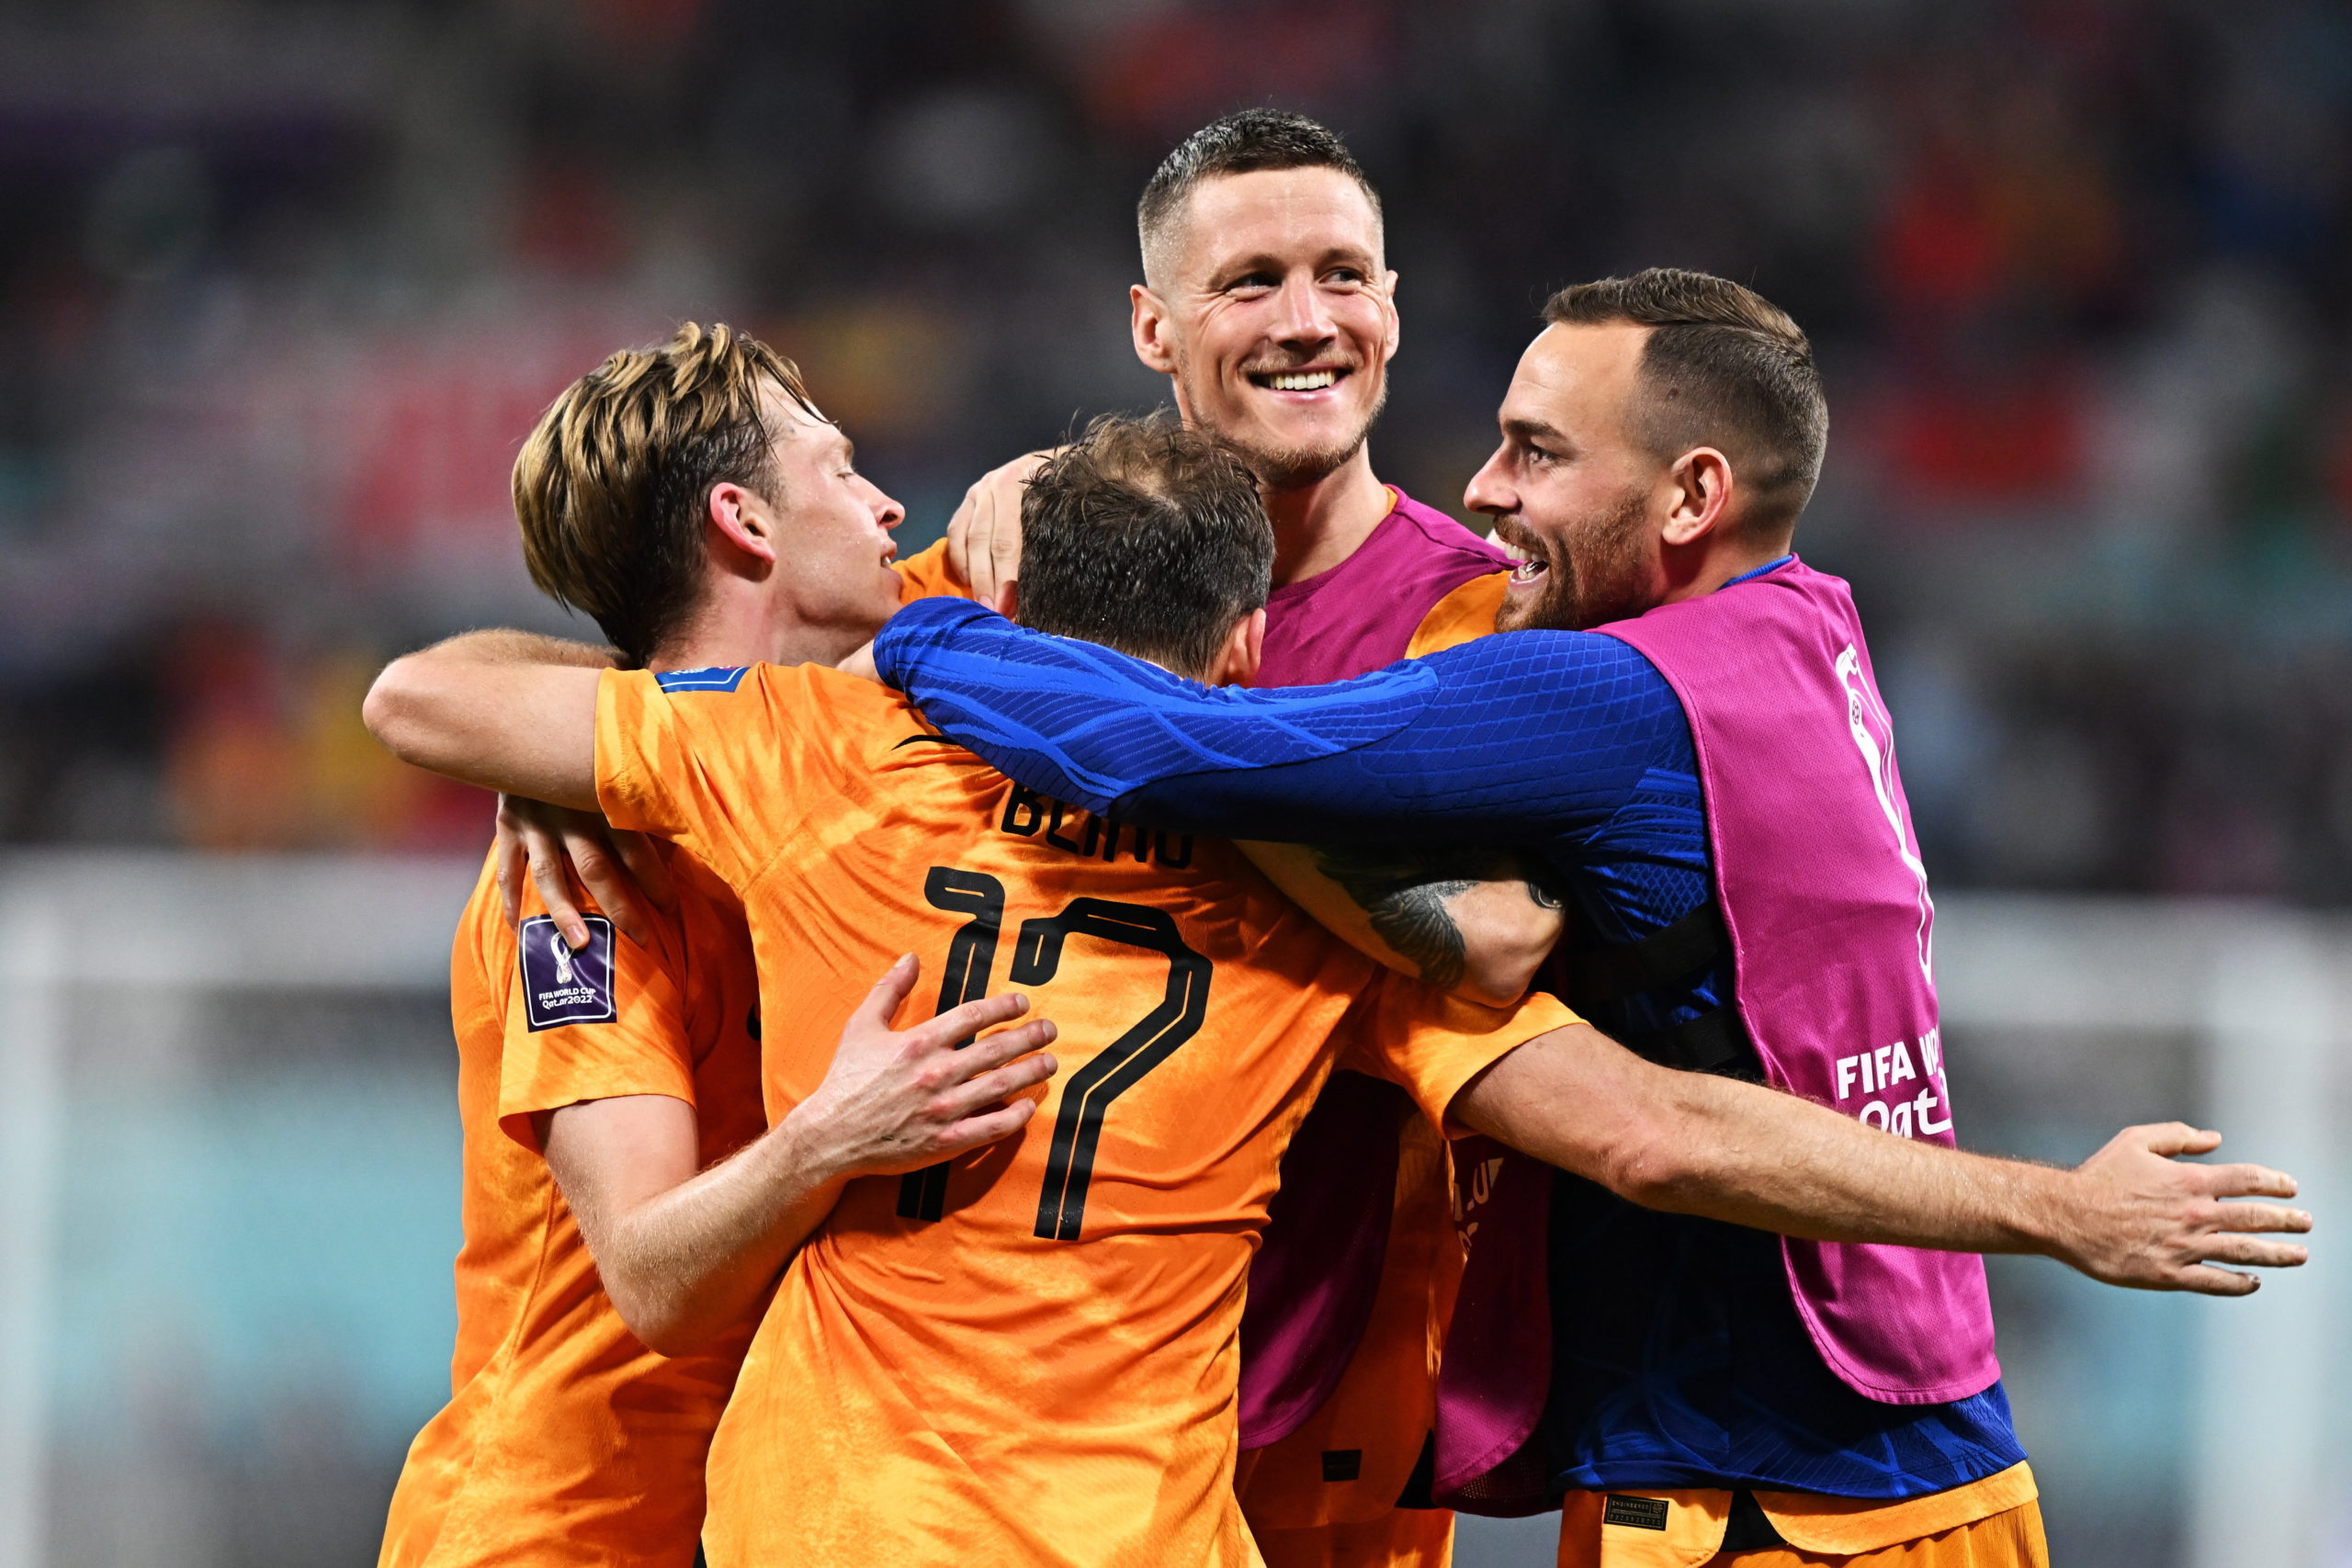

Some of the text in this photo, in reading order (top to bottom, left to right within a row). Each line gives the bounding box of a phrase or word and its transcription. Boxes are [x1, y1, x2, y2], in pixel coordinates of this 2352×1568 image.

[538, 987, 596, 1000] FIFA WORLD CUP
[897, 865, 1214, 1241] 17
[1837, 1041, 1917, 1100] FIFA
